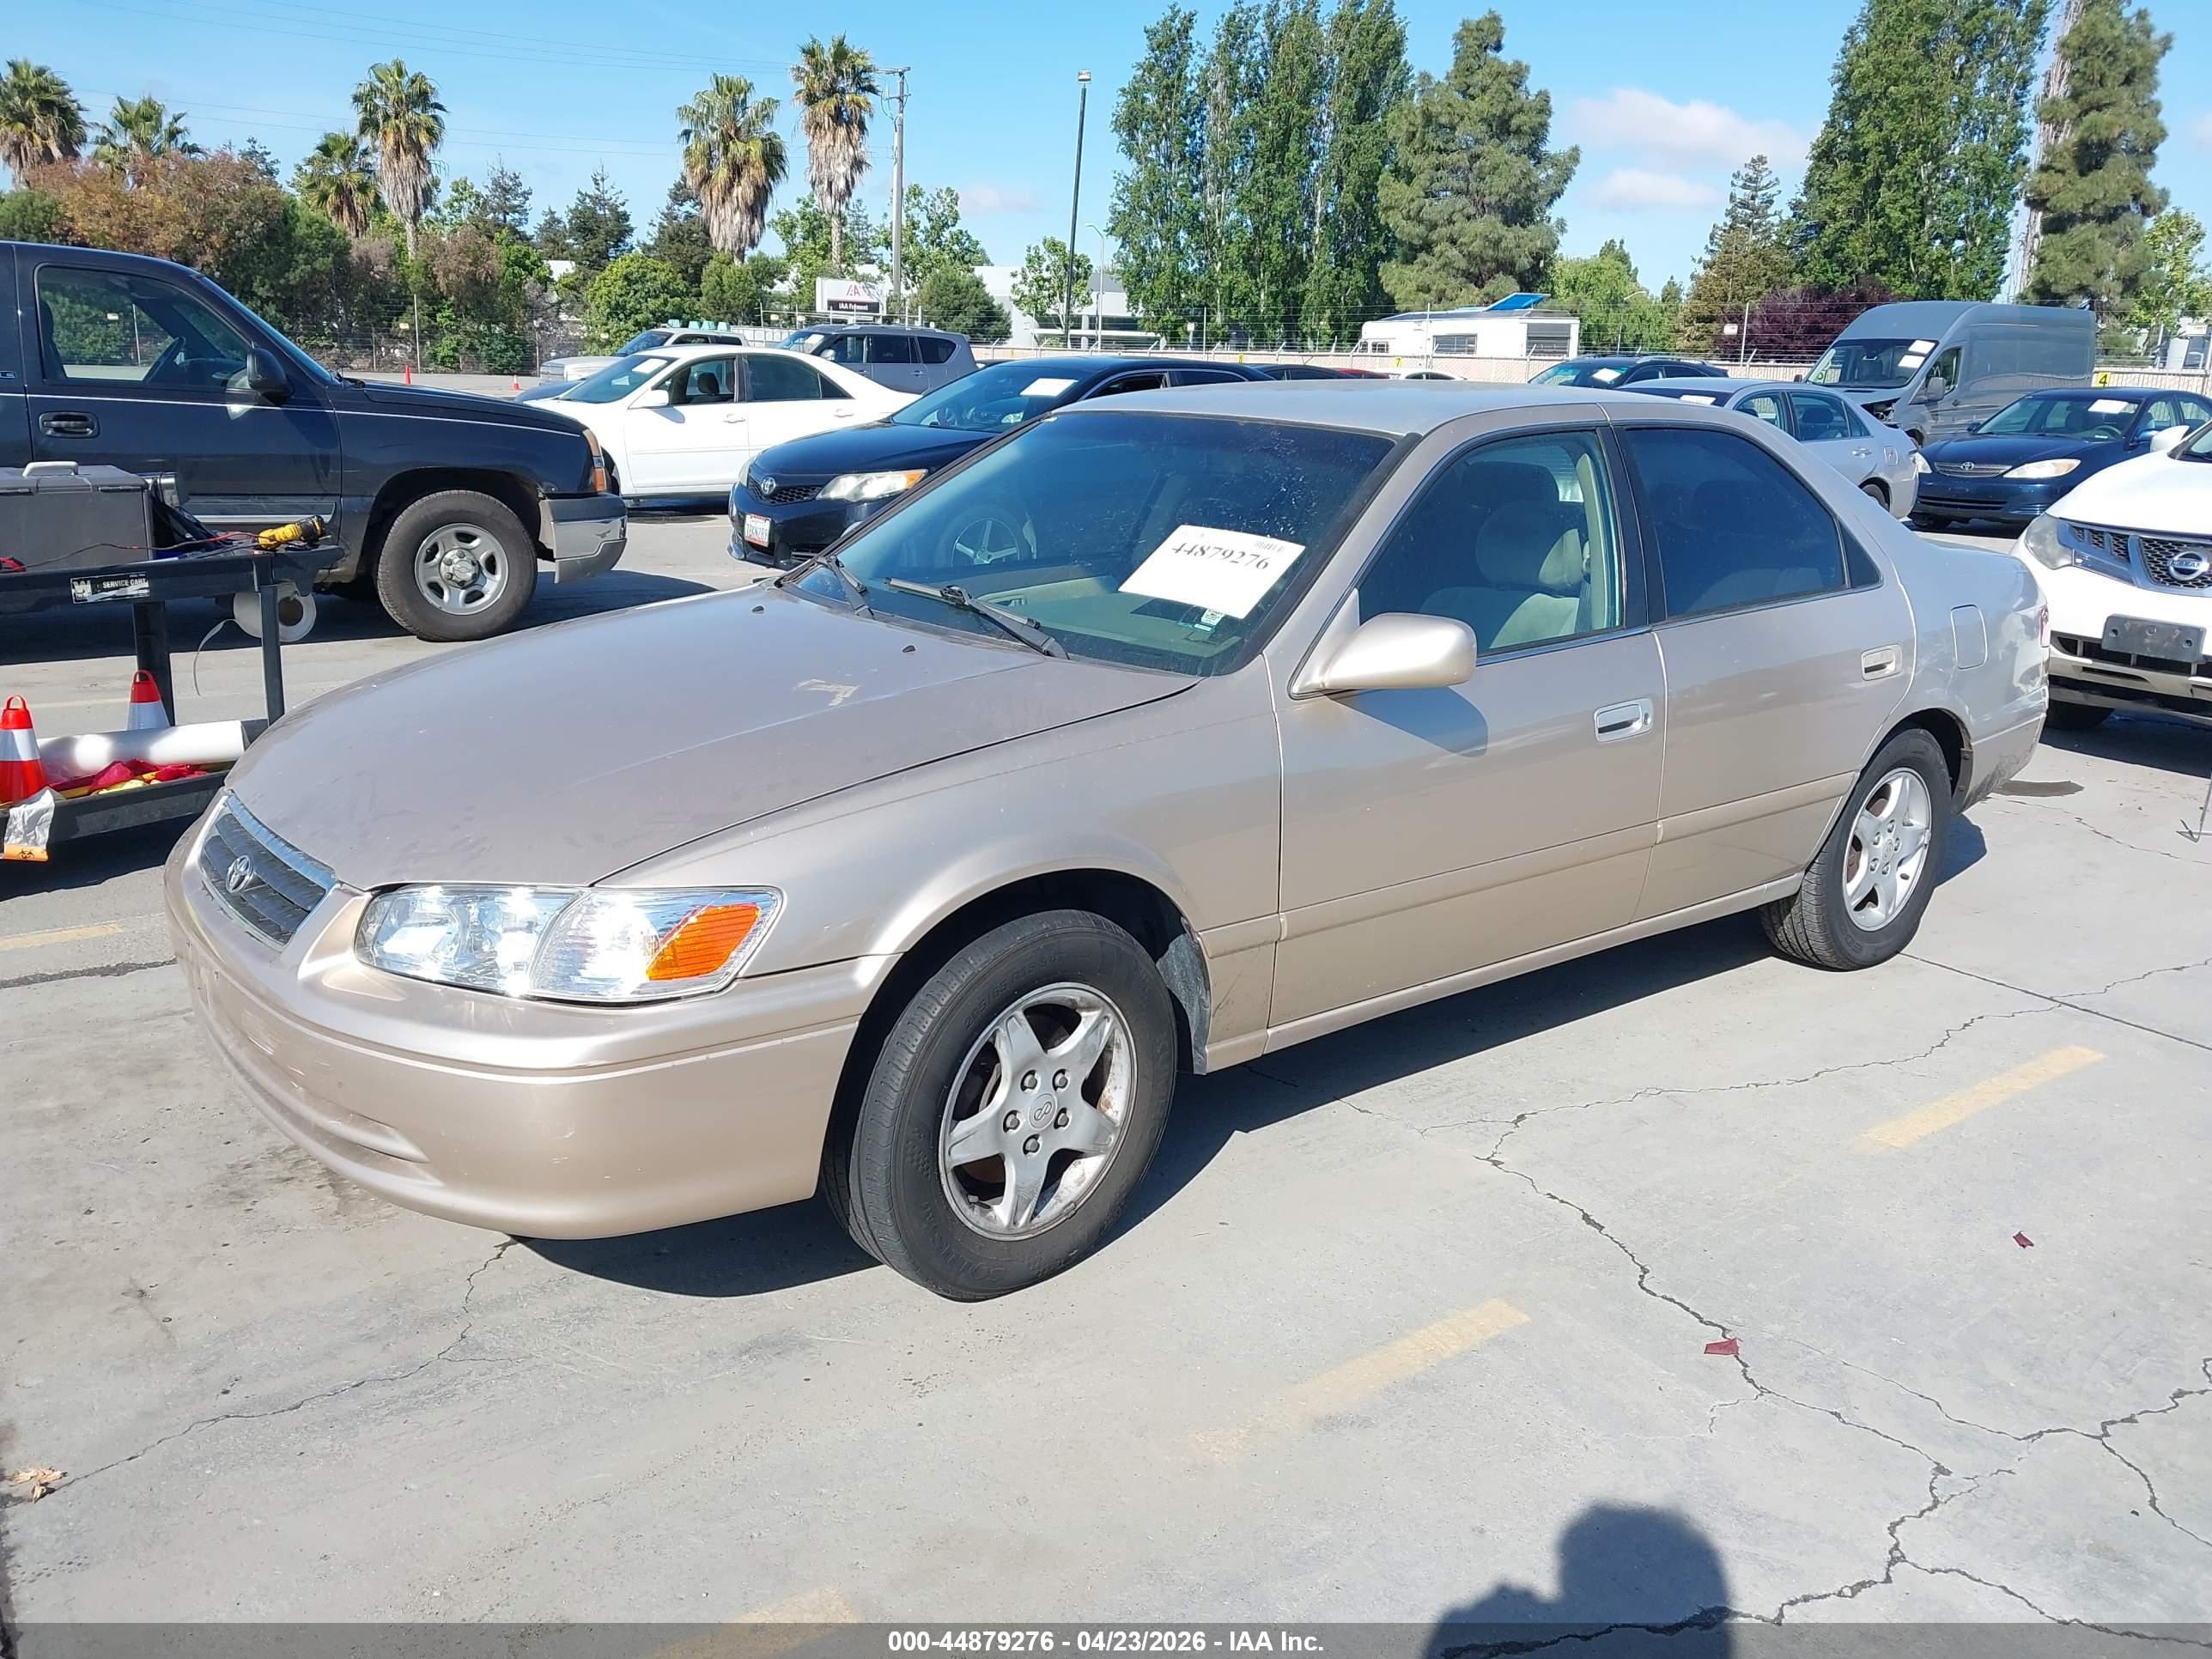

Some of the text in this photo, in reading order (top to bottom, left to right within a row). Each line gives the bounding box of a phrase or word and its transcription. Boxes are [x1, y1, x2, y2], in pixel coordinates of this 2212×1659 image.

[1396, 357, 1401, 368] 7
[2099, 374, 2108, 388] 4
[1172, 542, 1272, 570] 44879276
[102, 578, 146, 589] SERVICE CART
